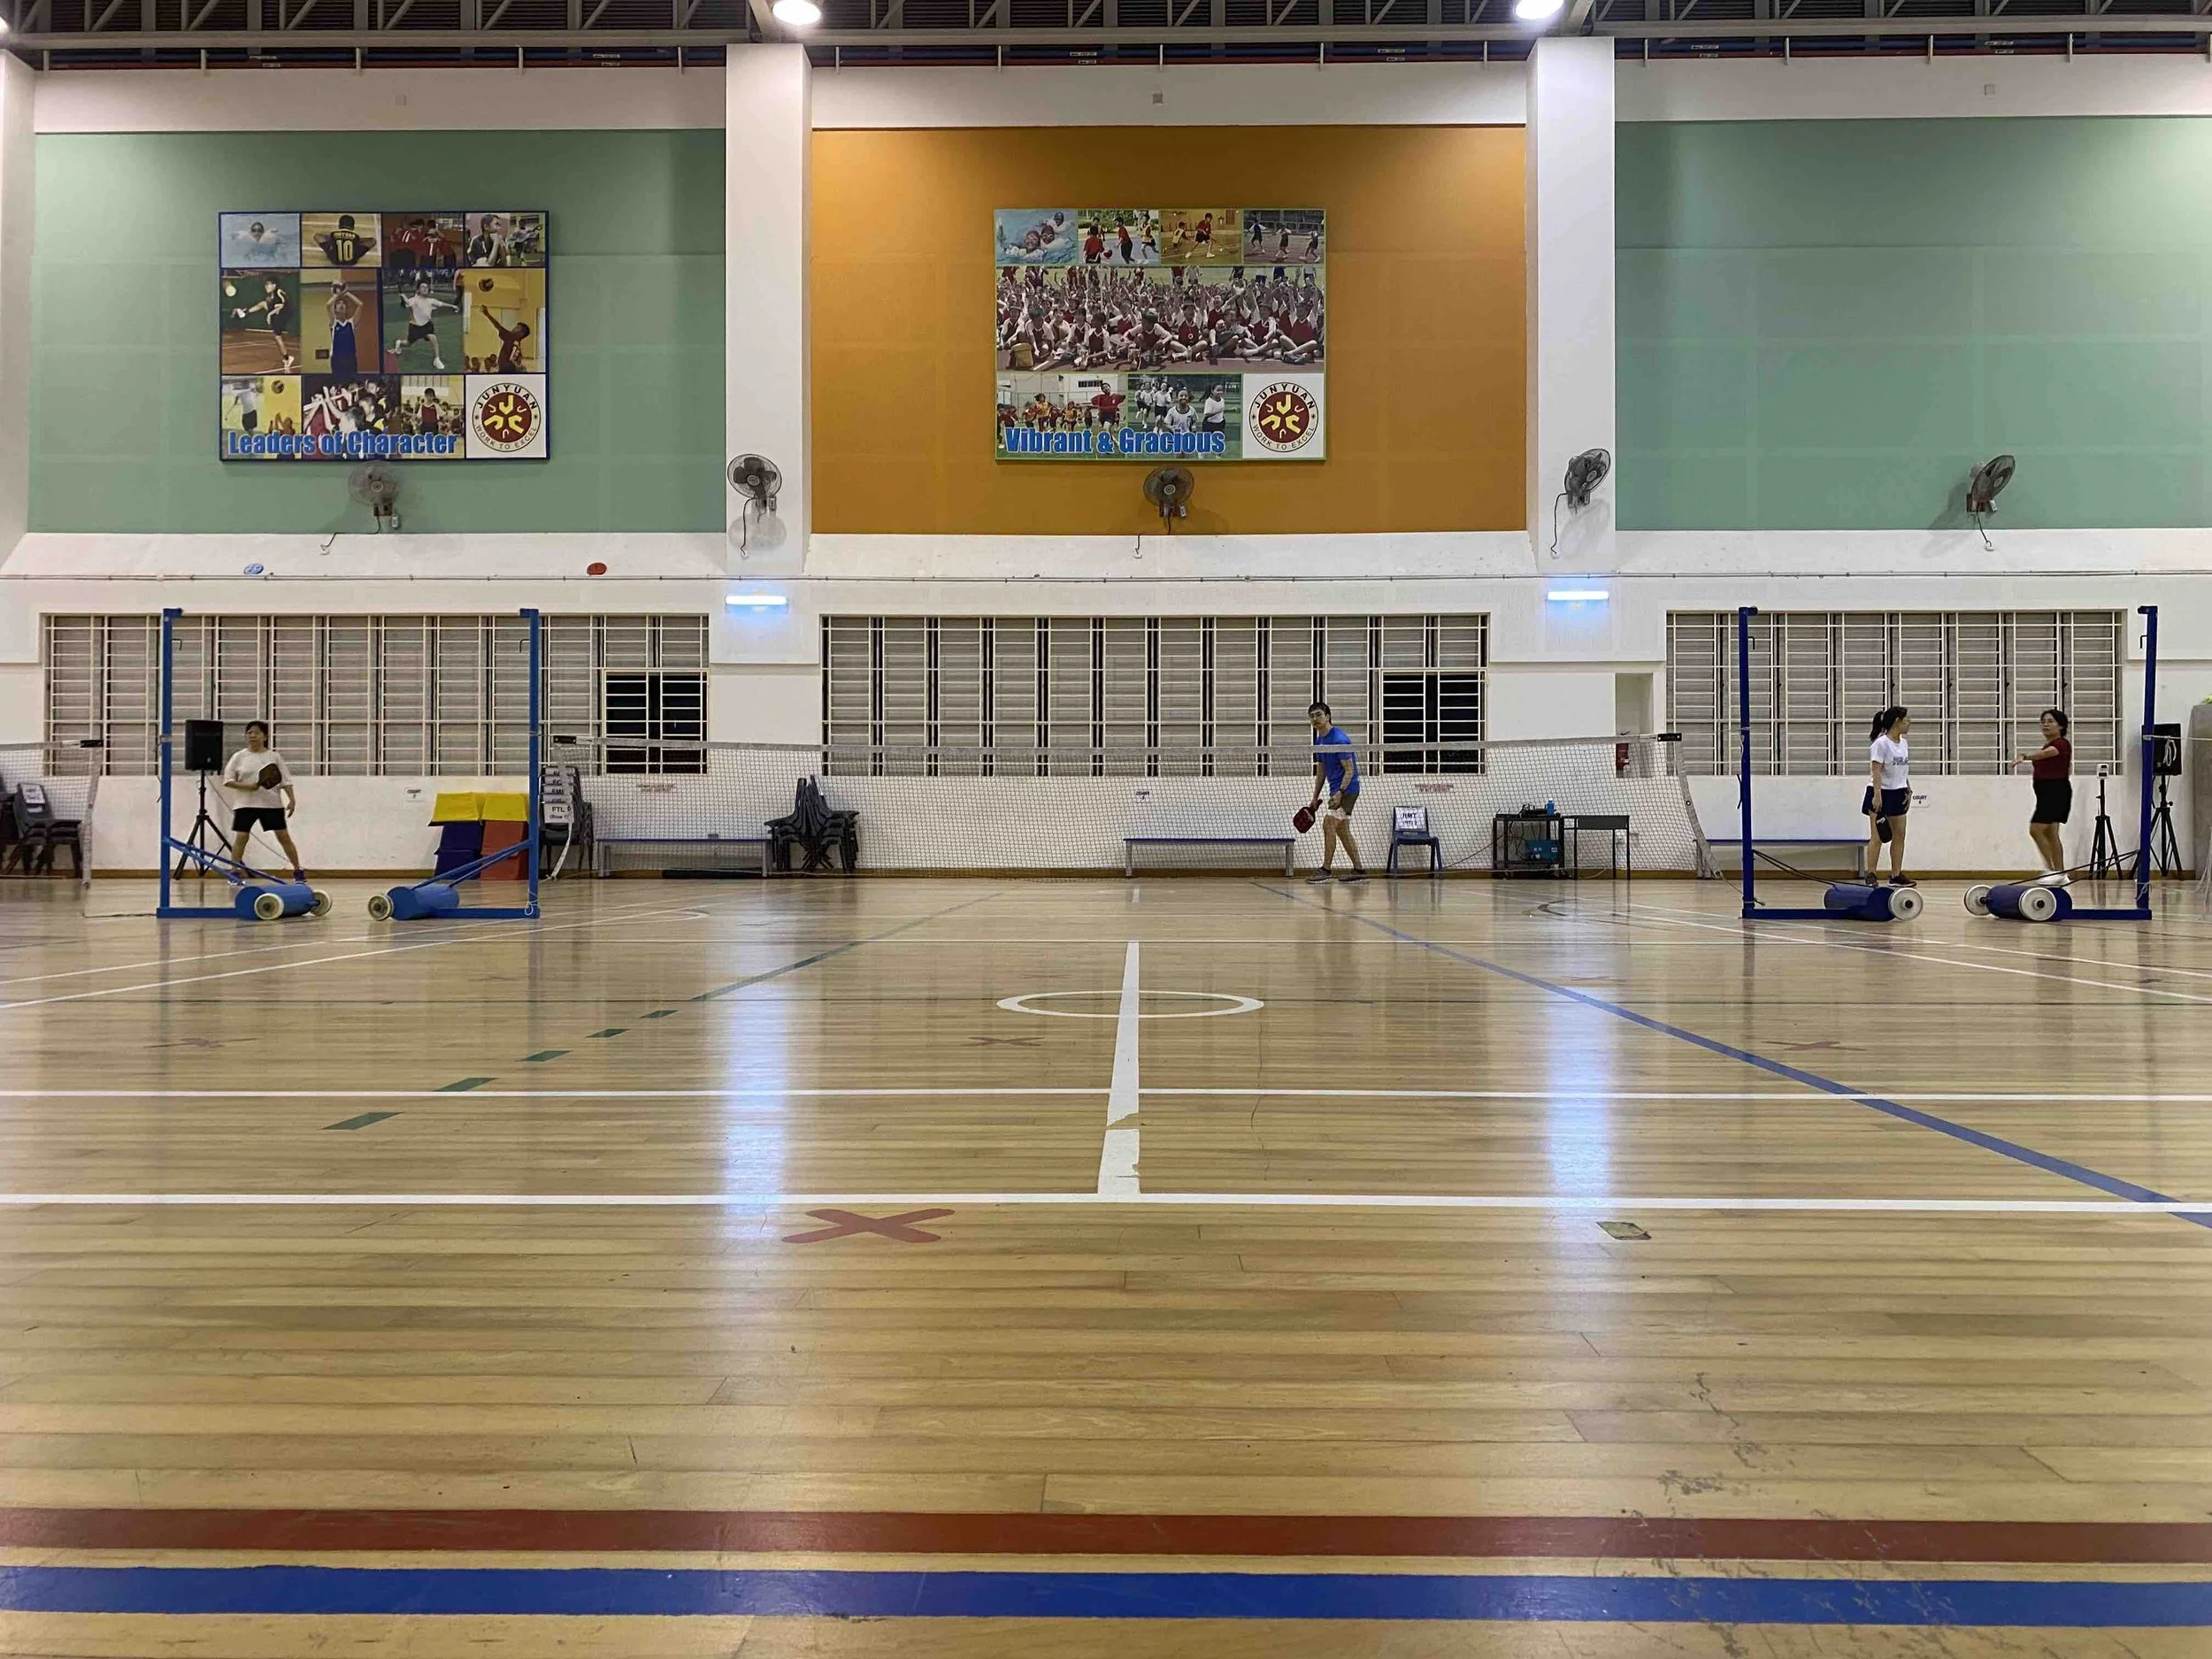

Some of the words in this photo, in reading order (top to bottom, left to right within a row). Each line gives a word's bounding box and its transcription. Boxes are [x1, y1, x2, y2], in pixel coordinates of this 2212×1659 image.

[336, 240, 353, 262] 10
[477, 384, 538, 410] JUNYUAN
[1254, 383, 1316, 410] JUNYUAN
[228, 431, 317, 455] Leaders
[319, 431, 343, 455] of
[346, 431, 457, 455] Character
[475, 425, 495, 447] WORK
[514, 426, 537, 449] EXCEL
[1005, 427, 1092, 454] Vibrant
[1096, 430, 1115, 454] &
[1118, 427, 1225, 454] Gracious
[1253, 424, 1273, 447] WORK
[1291, 426, 1315, 449] EXCEL
